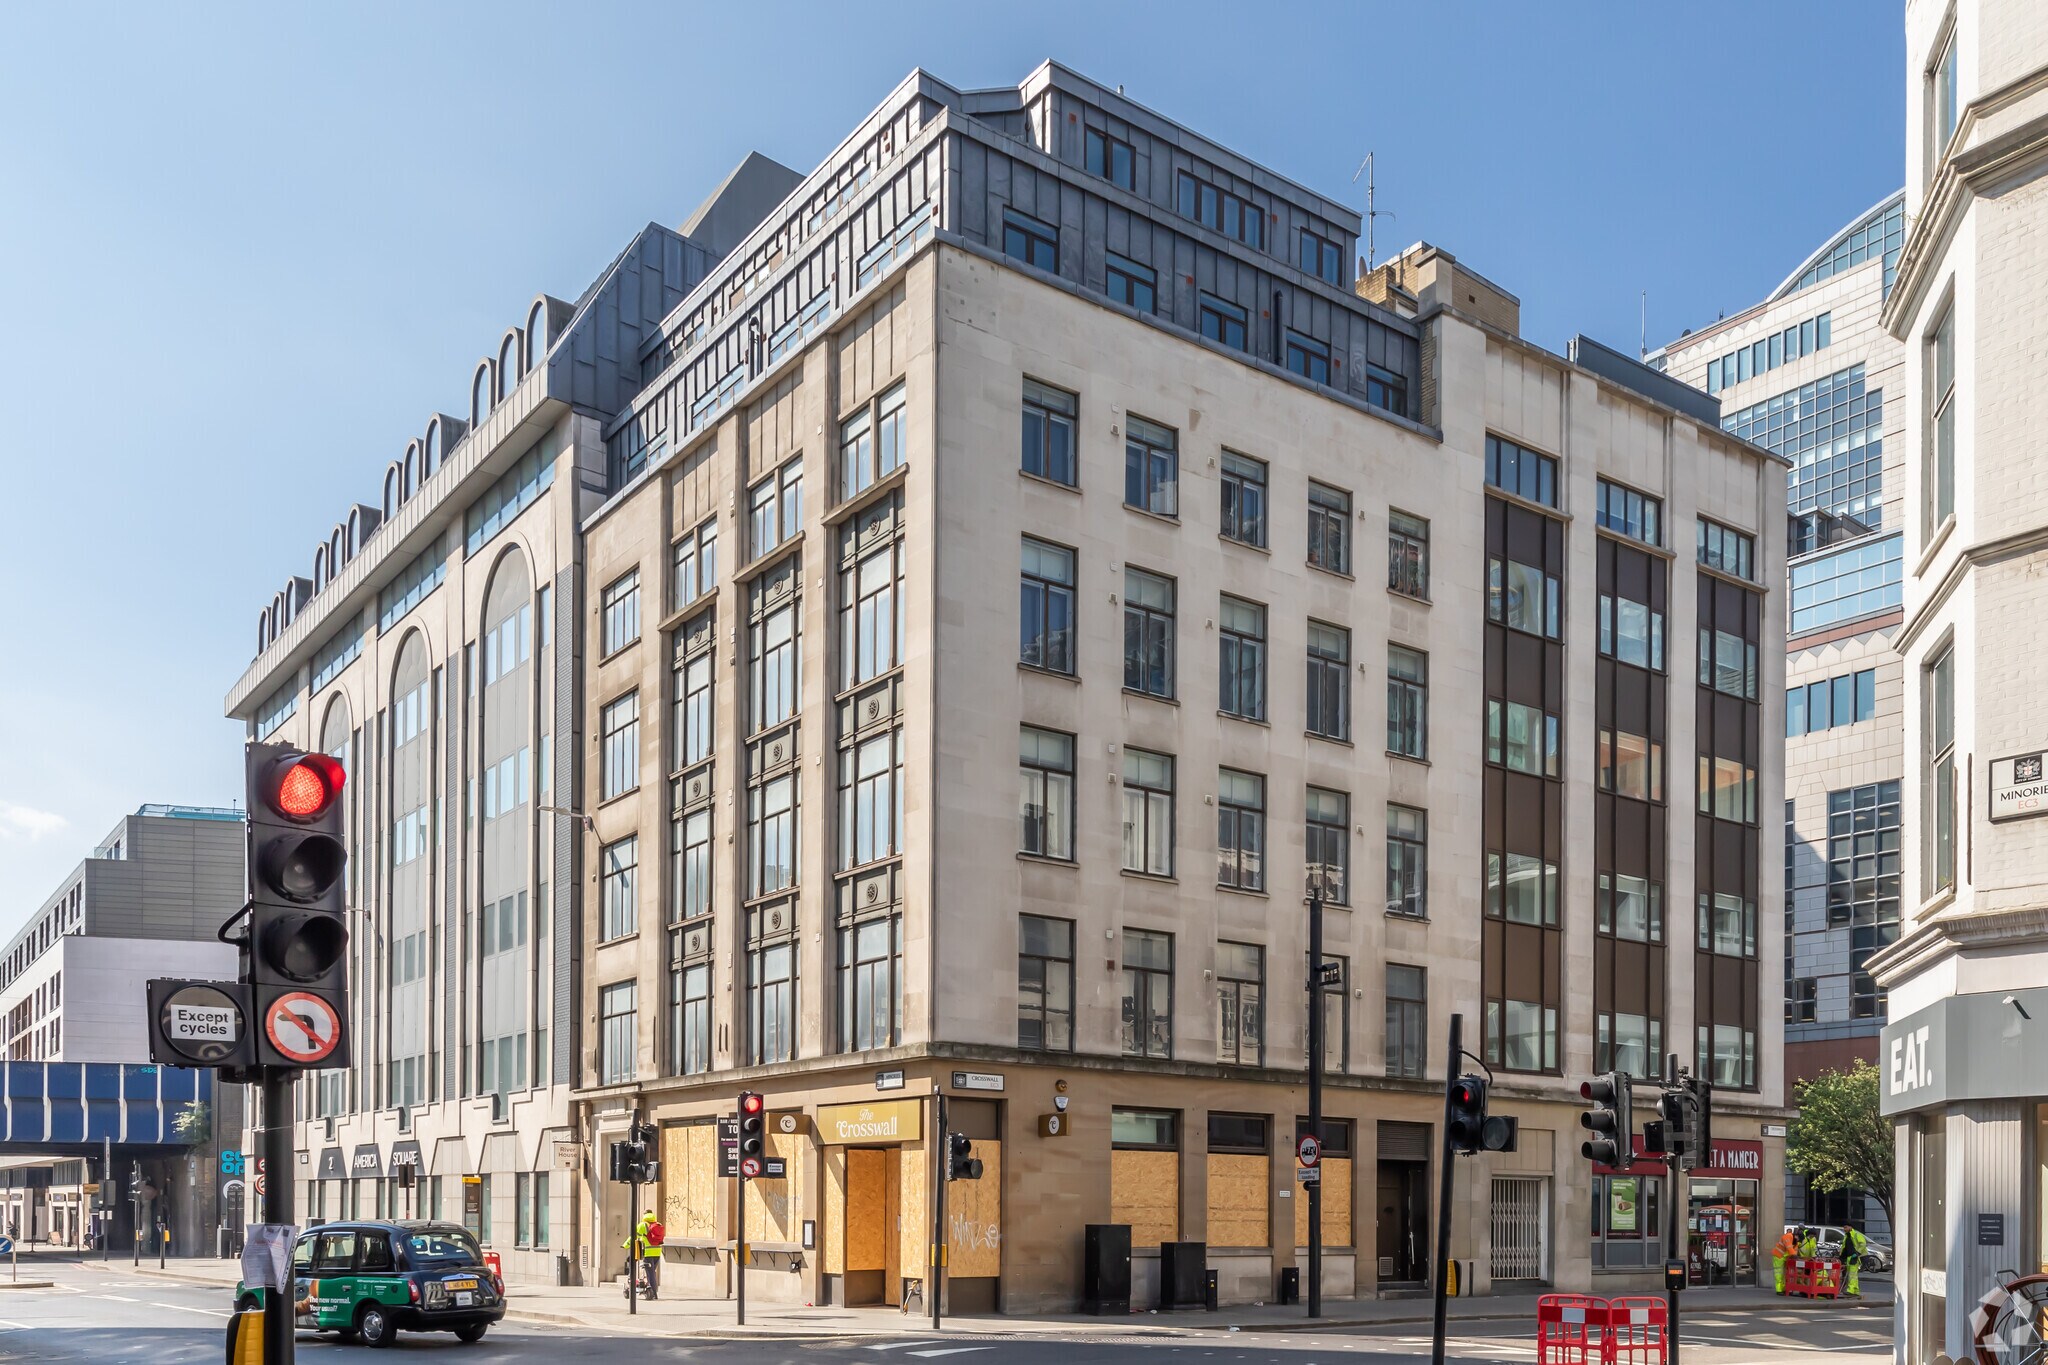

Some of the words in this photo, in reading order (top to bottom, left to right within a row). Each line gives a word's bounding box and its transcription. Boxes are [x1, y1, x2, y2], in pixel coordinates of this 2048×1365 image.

[2018, 799, 2038, 809] EC3
[178, 1009, 229, 1025] Except
[180, 1023, 228, 1036] cycles
[1890, 1025, 1932, 1096] EAT.
[971, 1075, 999, 1083] CROSSWALL
[859, 1108, 874, 1121] The
[836, 1116, 898, 1138] Crosswall
[328, 1156, 334, 1170] 2
[353, 1153, 378, 1169] AMERICA
[392, 1150, 418, 1166] SQUARE
[558, 1151, 578, 1159] House
[1720, 1150, 1726, 1168] A
[1727, 1150, 1759, 1169] MANGER
[309, 1295, 318, 1303] The
[309, 1304, 321, 1312] Your
[321, 1304, 338, 1312] usual?
